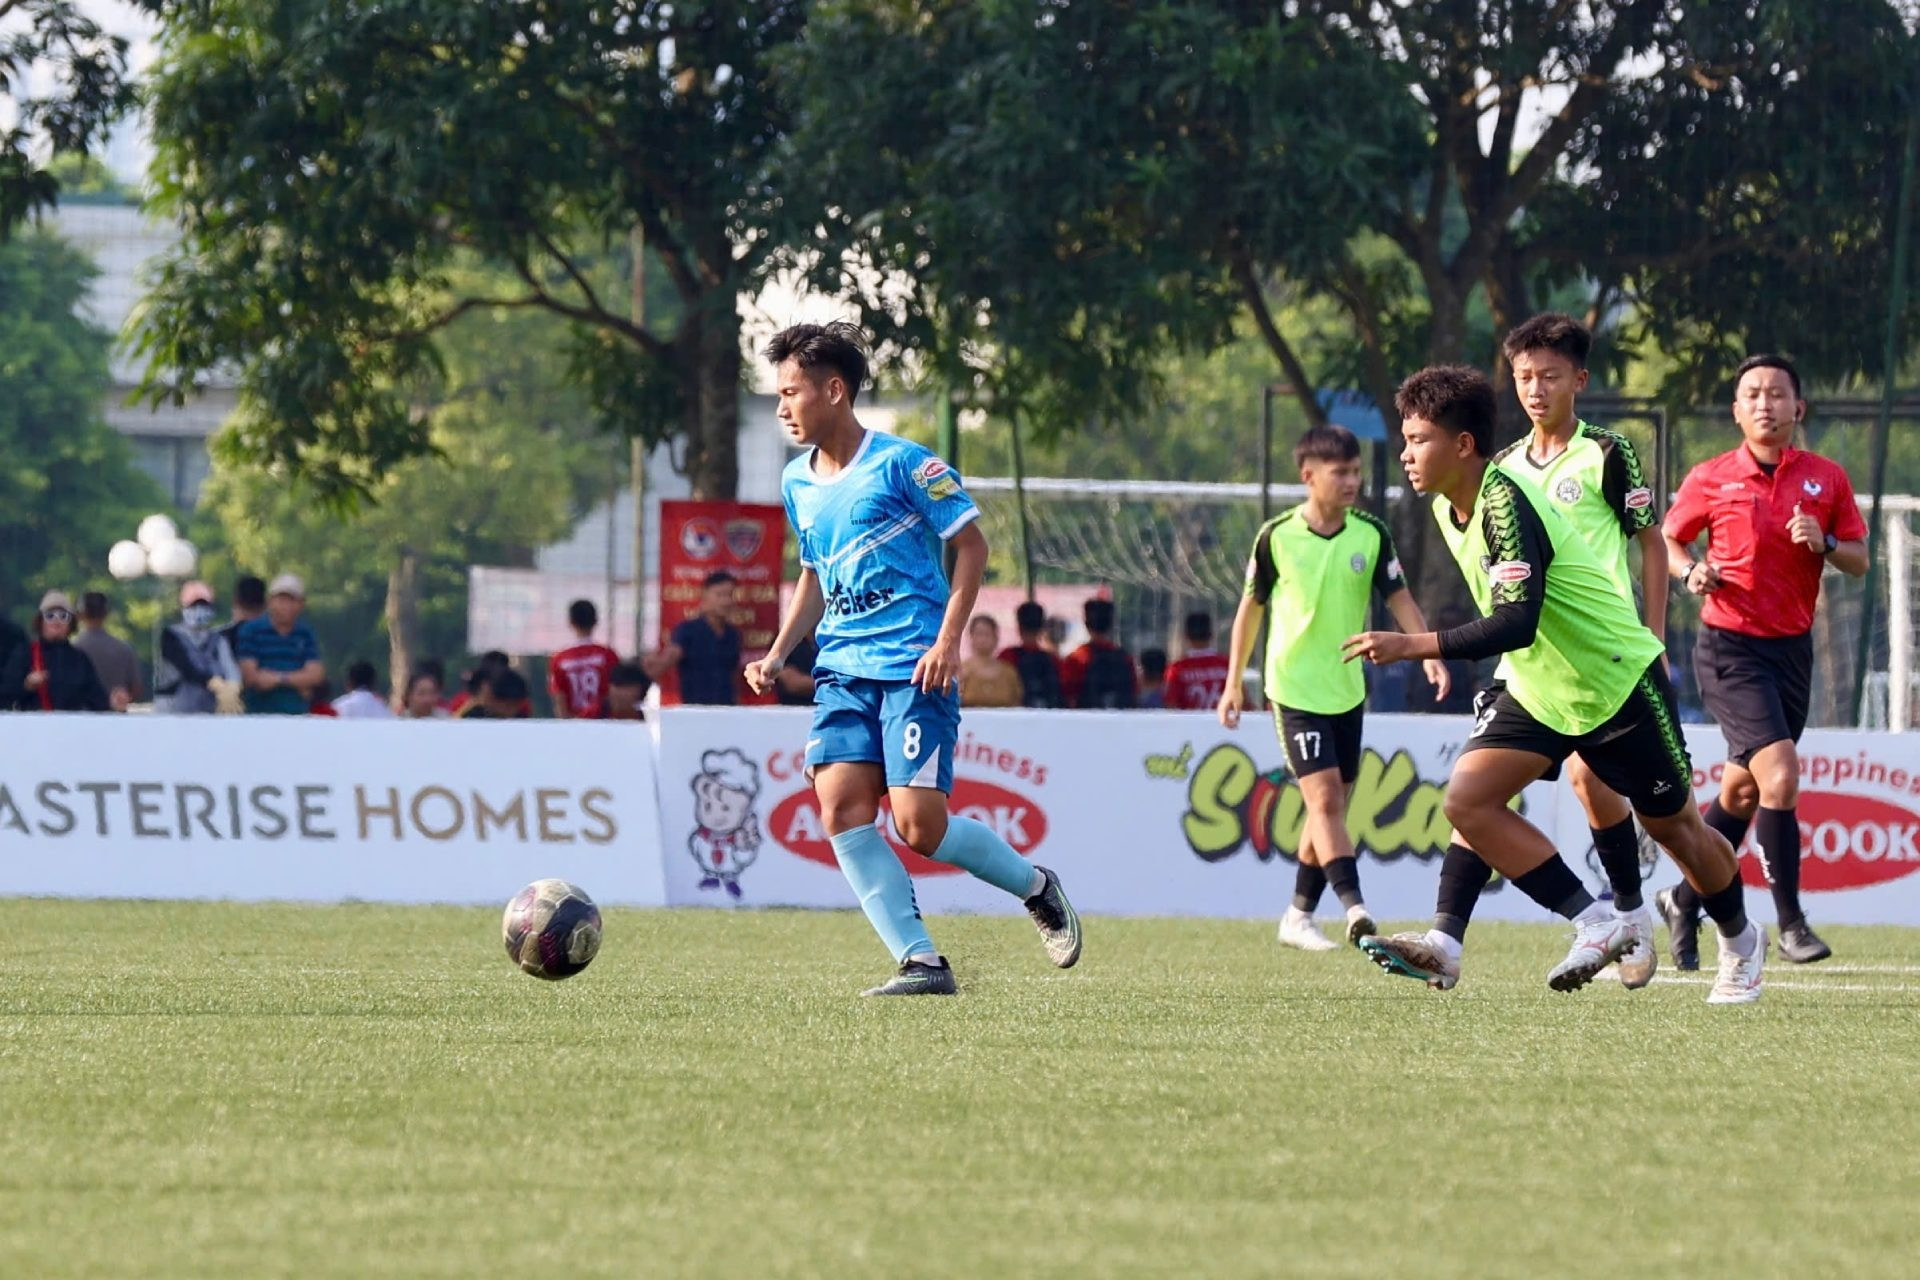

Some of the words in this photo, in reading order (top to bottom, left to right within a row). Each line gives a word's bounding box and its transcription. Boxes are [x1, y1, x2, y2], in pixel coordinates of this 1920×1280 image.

[902, 721, 922, 760] 8
[1293, 731, 1321, 761] 17
[353, 784, 619, 843] HOMES
